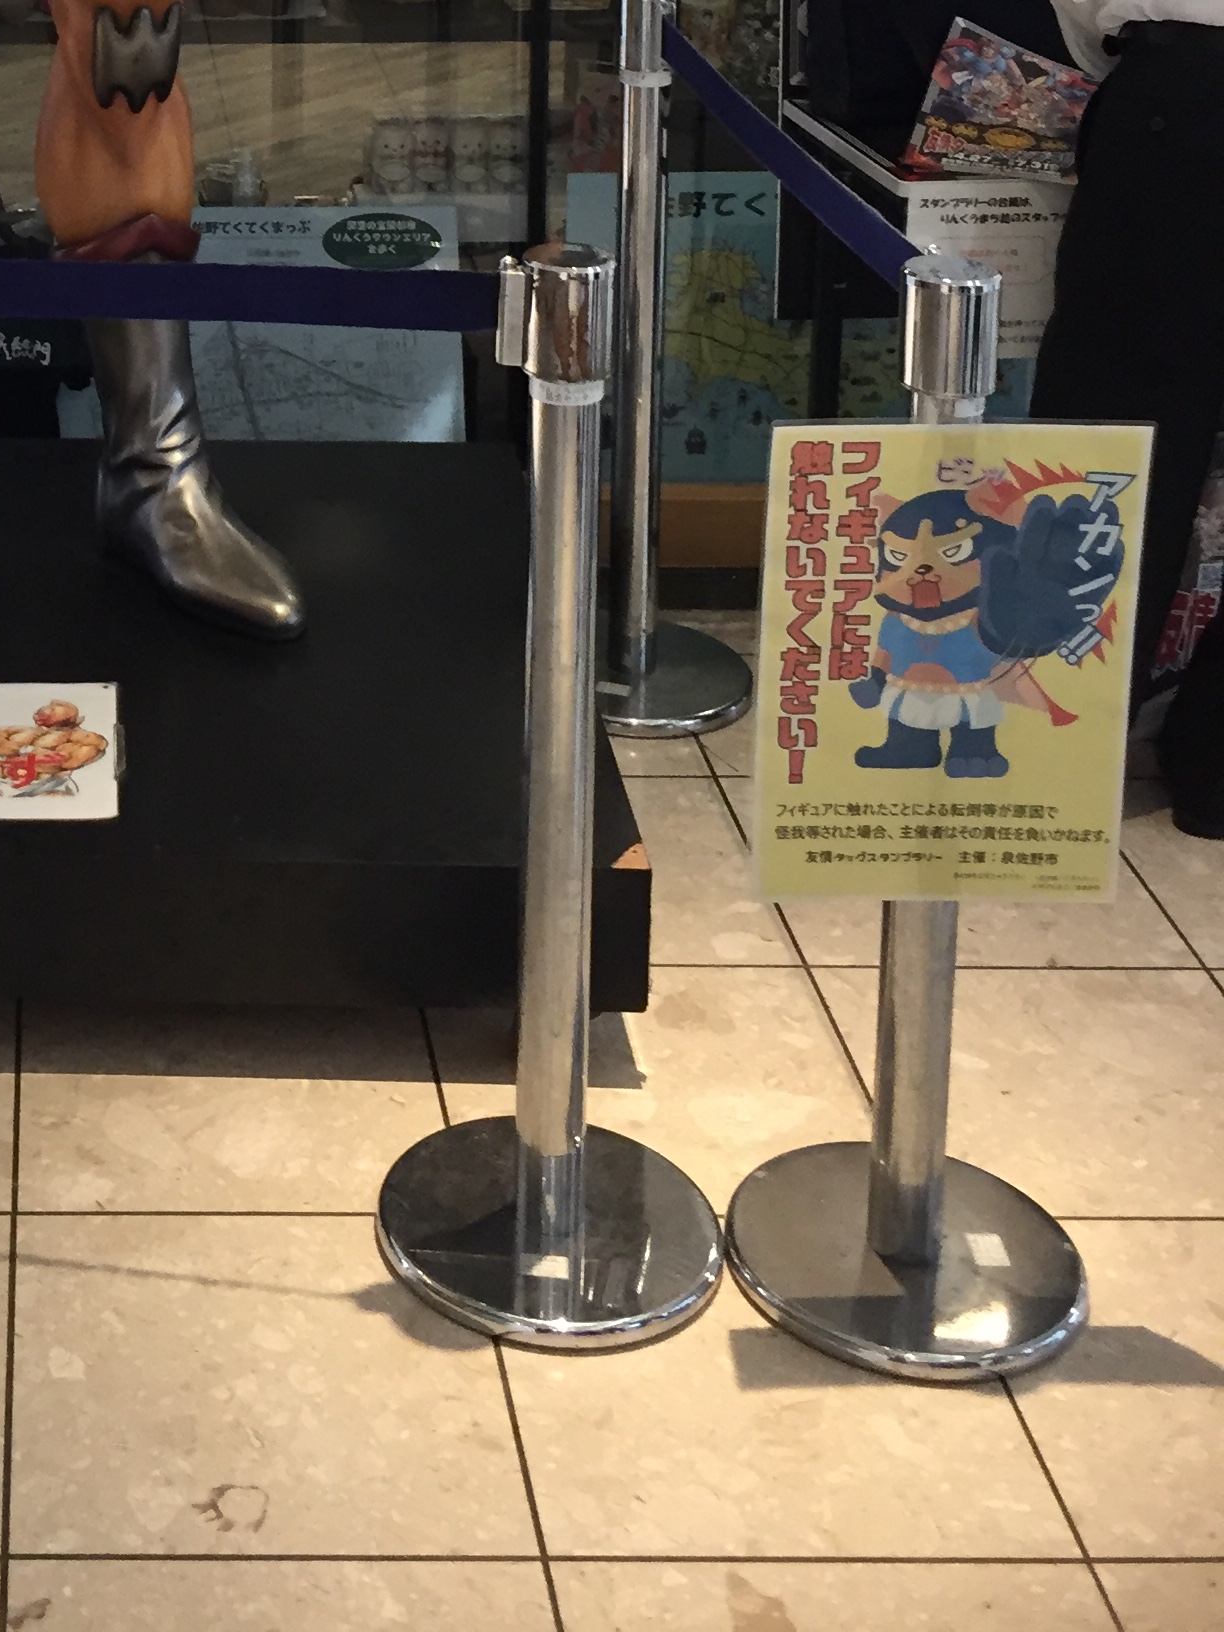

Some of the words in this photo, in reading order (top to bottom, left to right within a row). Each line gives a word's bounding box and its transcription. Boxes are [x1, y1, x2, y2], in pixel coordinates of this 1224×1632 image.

[827, 440, 882, 681] フィギュアには
